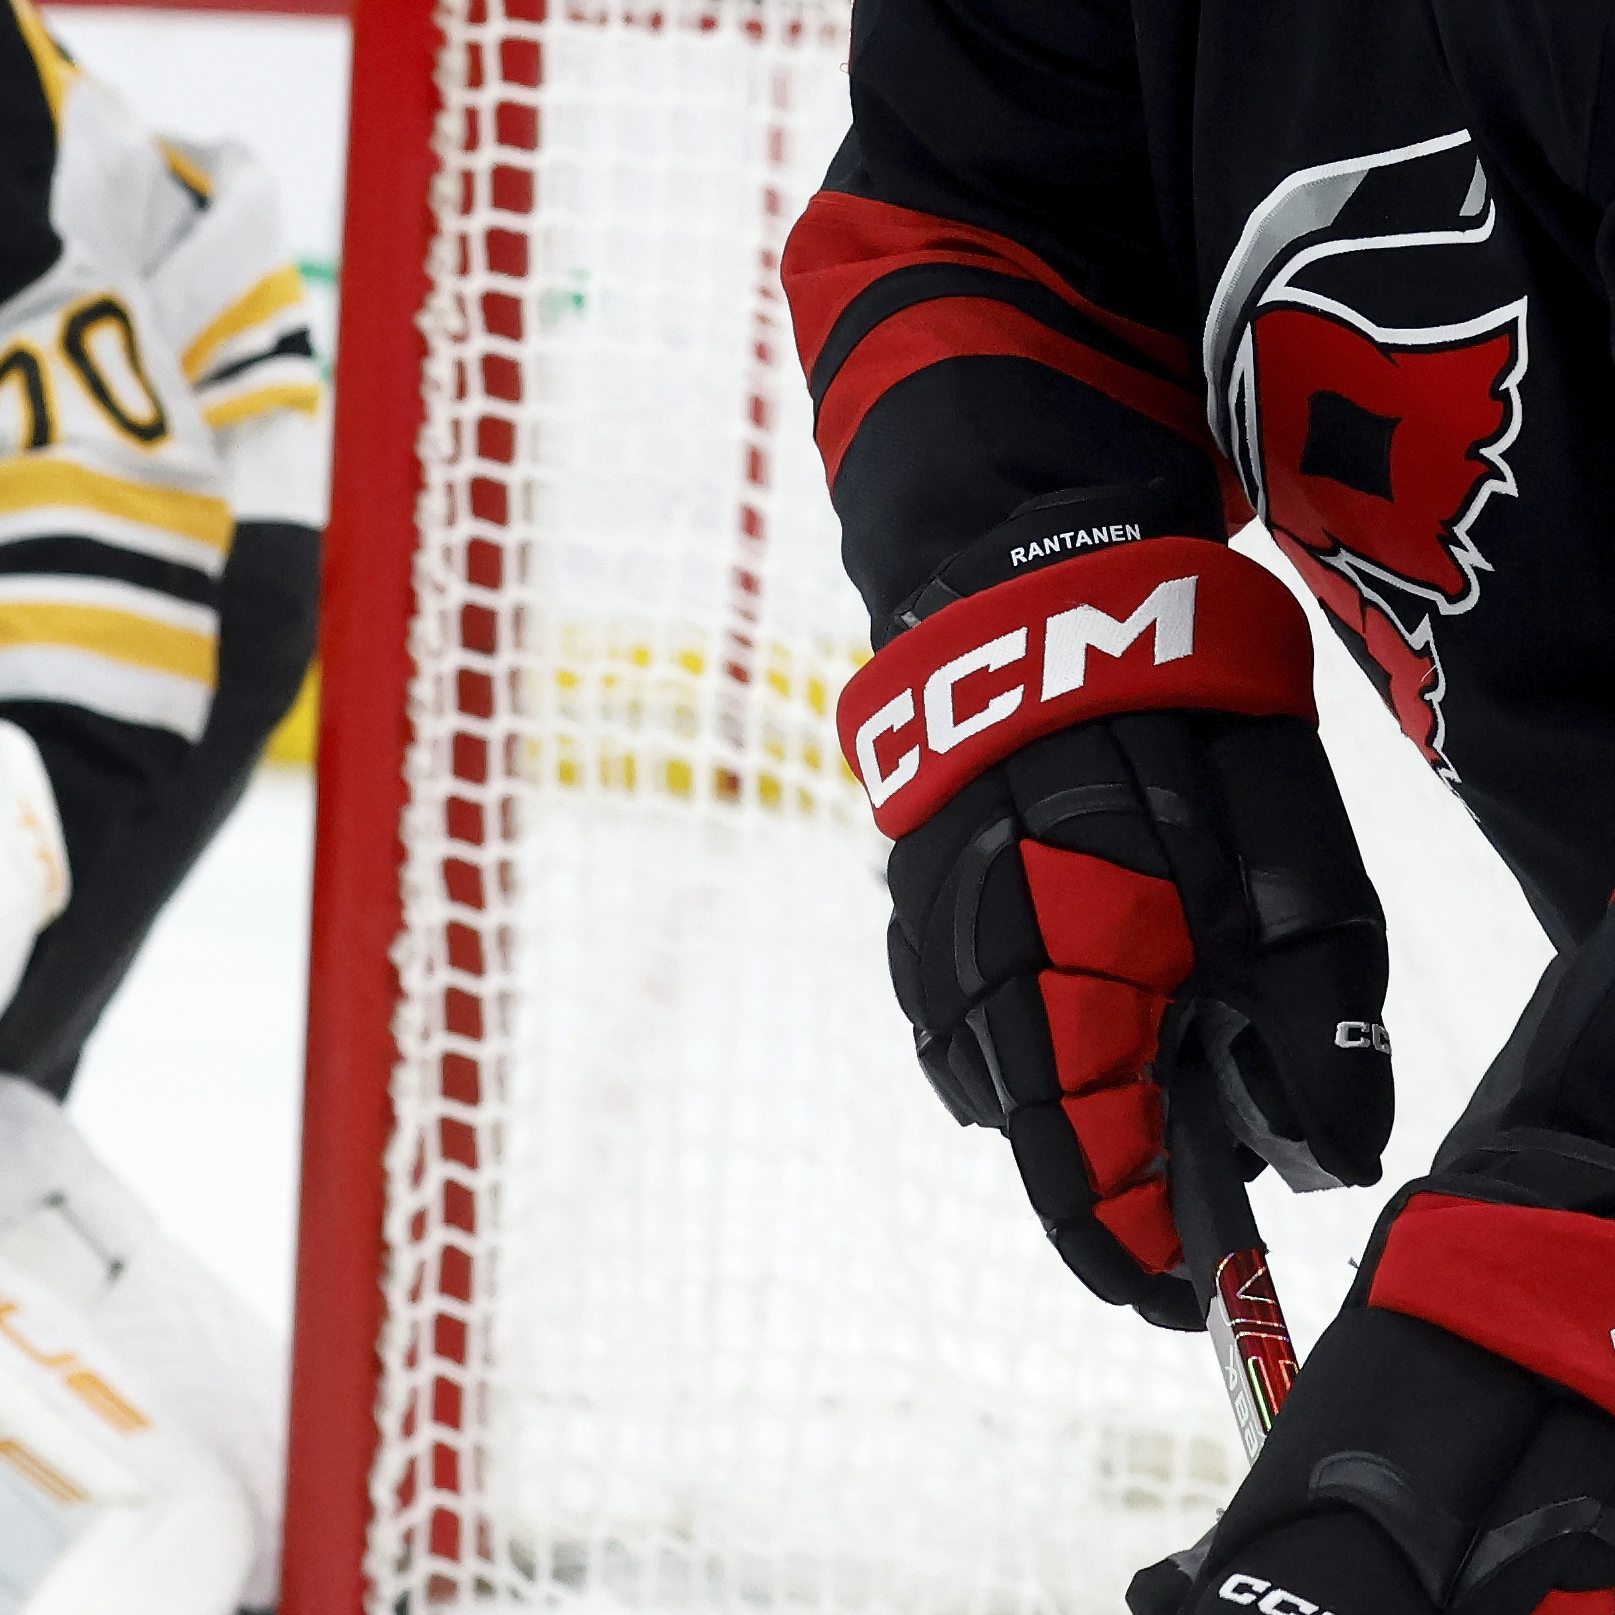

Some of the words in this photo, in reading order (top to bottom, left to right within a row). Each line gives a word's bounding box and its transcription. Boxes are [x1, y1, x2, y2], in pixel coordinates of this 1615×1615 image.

[1010, 523, 1142, 567] RANTANEN
[855, 574, 1200, 809] CCM
[1219, 1573, 1336, 1615] CC
